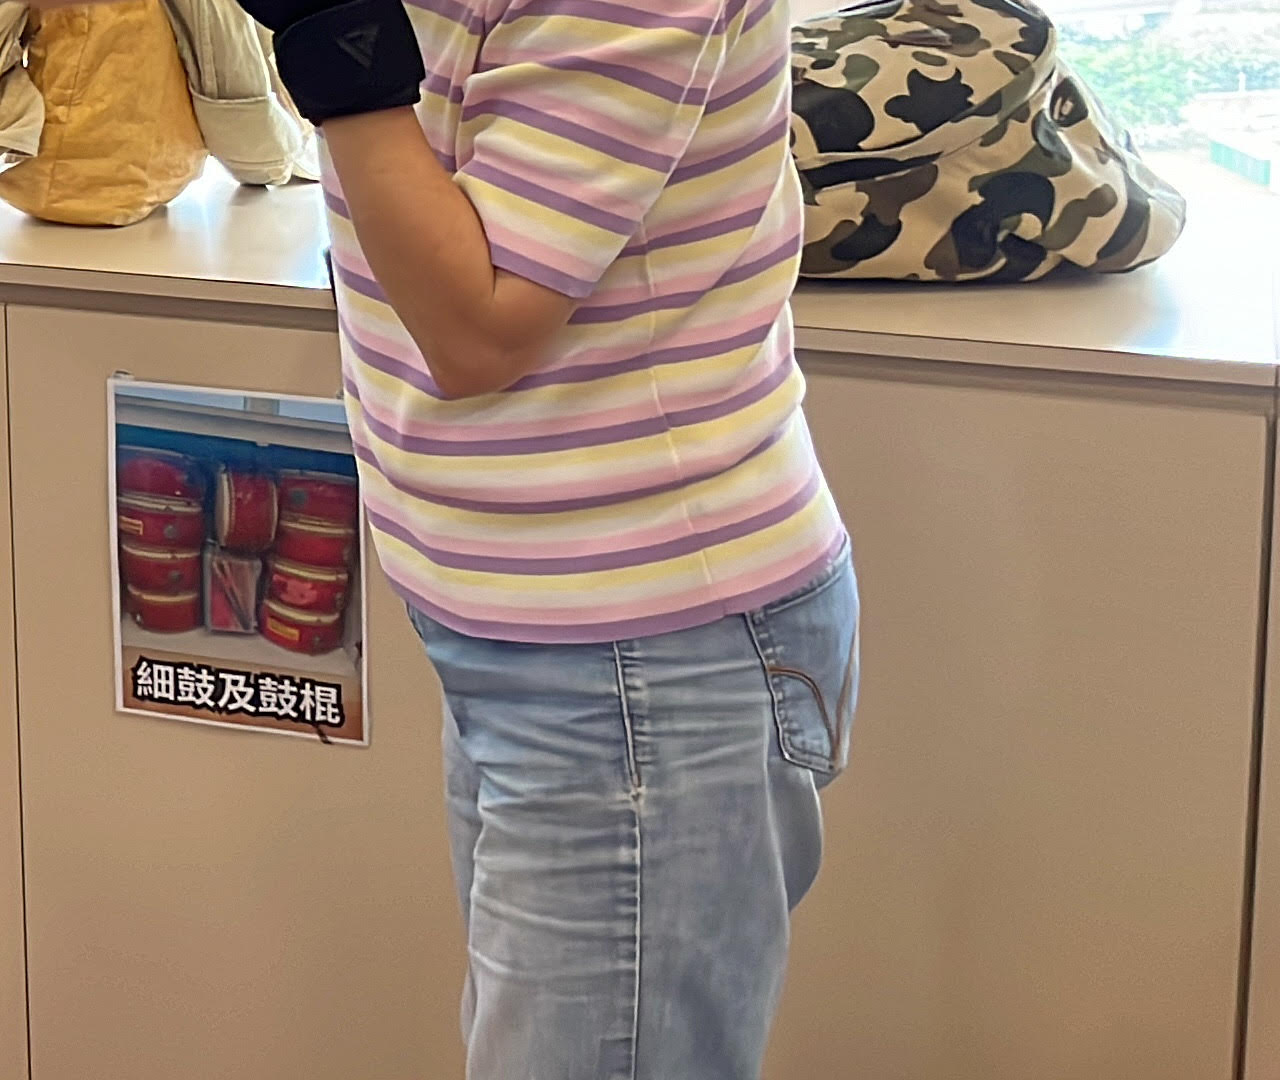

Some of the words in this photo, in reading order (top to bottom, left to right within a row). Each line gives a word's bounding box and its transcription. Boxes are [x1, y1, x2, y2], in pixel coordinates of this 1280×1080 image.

[136, 661, 341, 724] 細鼓及鼓棍
